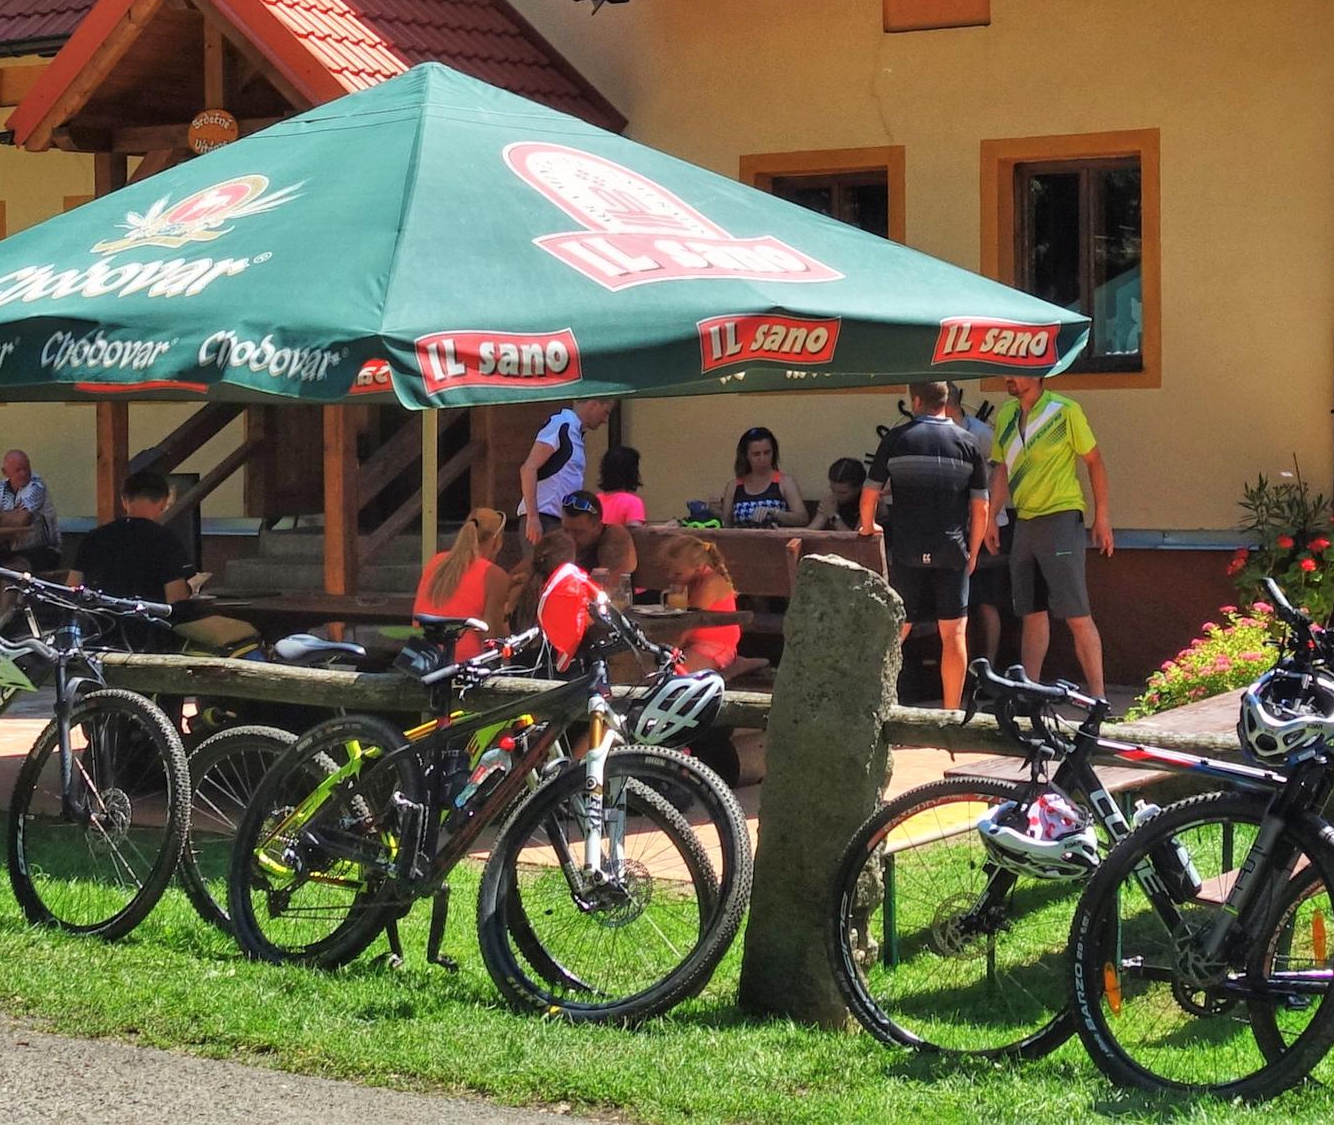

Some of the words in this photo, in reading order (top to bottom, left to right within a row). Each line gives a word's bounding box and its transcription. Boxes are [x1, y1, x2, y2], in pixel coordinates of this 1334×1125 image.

[558, 237, 665, 277] IL
[653, 239, 811, 273] sano
[40, 329, 171, 371] Chodovar
[198, 330, 343, 381] Chodovar
[427, 338, 466, 381] IL
[479, 340, 570, 376] sano
[709, 322, 743, 360] IL
[750, 323, 830, 355] sano
[942, 323, 973, 354] IL
[980, 328, 1049, 357] sano
[1090, 788, 1160, 896] CUE
[1074, 962, 1098, 1032] BARZO
